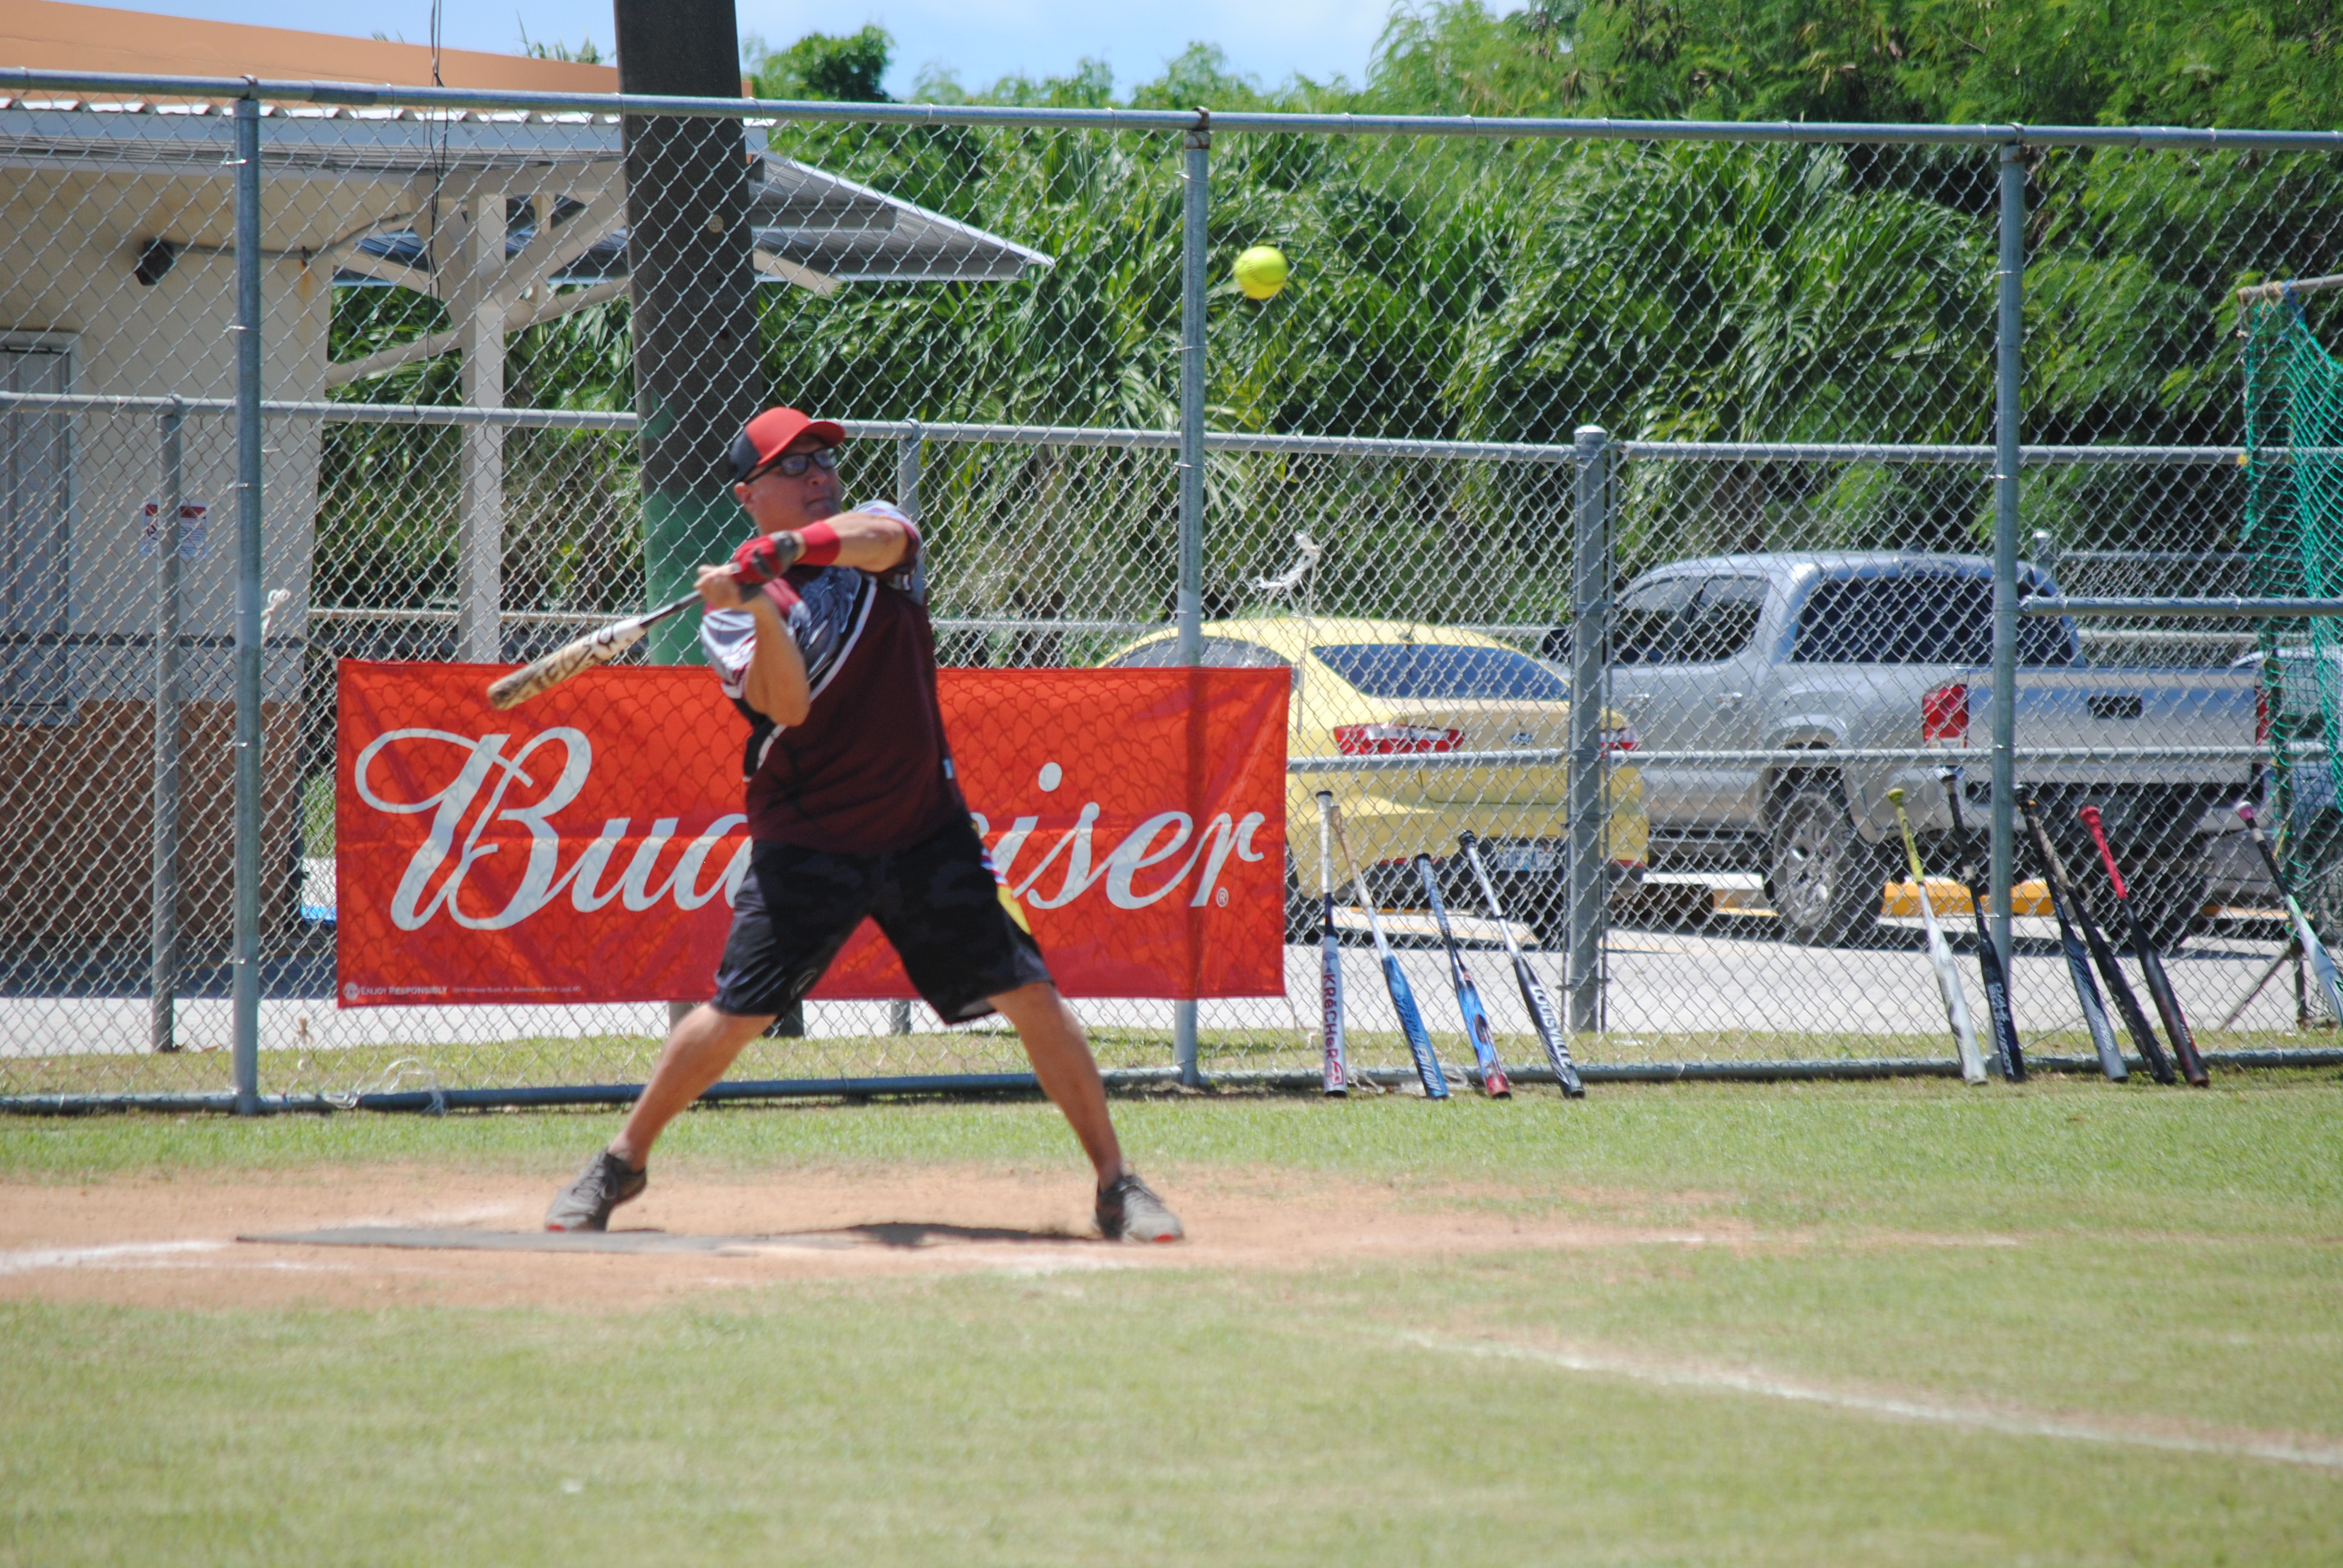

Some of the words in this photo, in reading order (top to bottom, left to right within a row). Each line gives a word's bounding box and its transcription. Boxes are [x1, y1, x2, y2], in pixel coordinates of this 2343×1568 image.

[361, 987, 387, 995] ENJOY
[388, 986, 448, 995] RESPONSIBLY
[1529, 984, 1572, 1068] LOUISVILLE
[1413, 1045, 1443, 1091] EDITION
